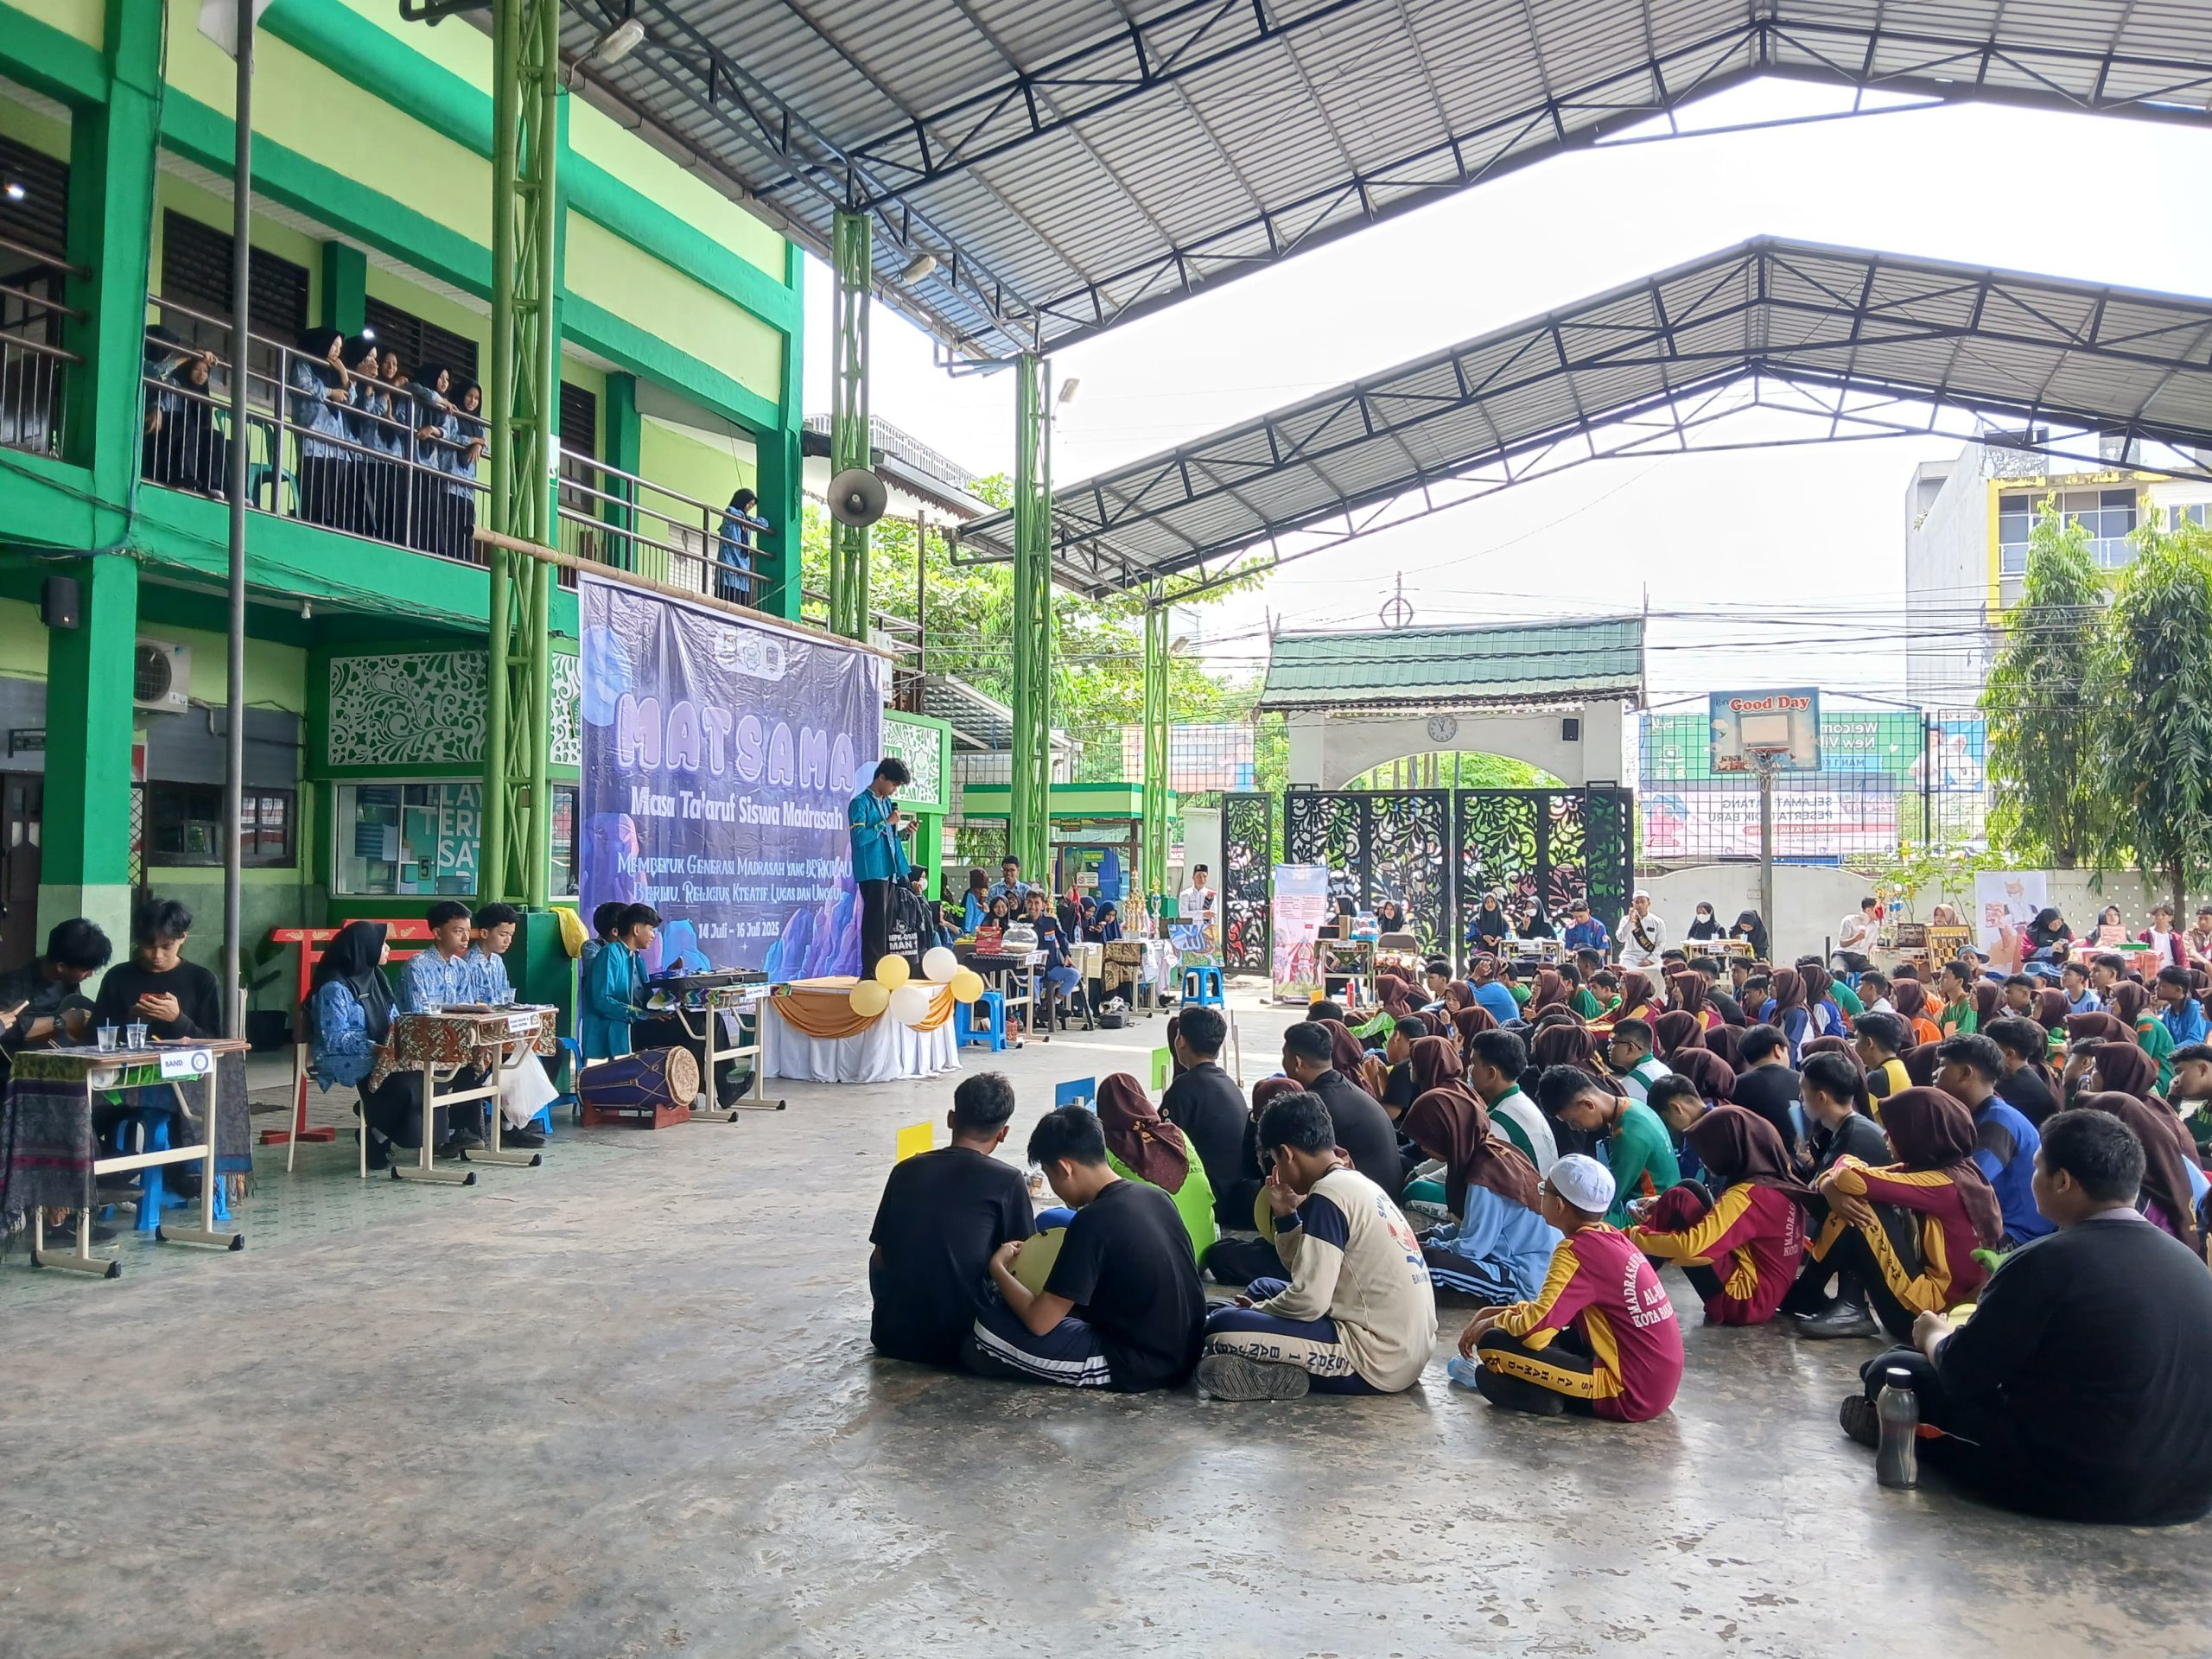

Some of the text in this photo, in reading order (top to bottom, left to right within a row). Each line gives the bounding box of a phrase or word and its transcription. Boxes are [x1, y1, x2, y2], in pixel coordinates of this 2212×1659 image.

[1729, 697, 1774, 712] Good
[1777, 696, 1810, 712] Day
[617, 692, 855, 793] MATSAMA
[739, 796, 780, 826] Siswa
[782, 801, 843, 830] Madrasah
[421, 859, 429, 878] 5
[736, 855, 785, 878] MADRASAH
[698, 923, 709, 938] 14
[710, 922, 728, 938] Juli
[736, 923, 745, 938] 16
[746, 921, 760, 938] Juli
[761, 921, 779, 937] 2025
[889, 941, 912, 950] MAN
[165, 1059, 184, 1068] BAND
